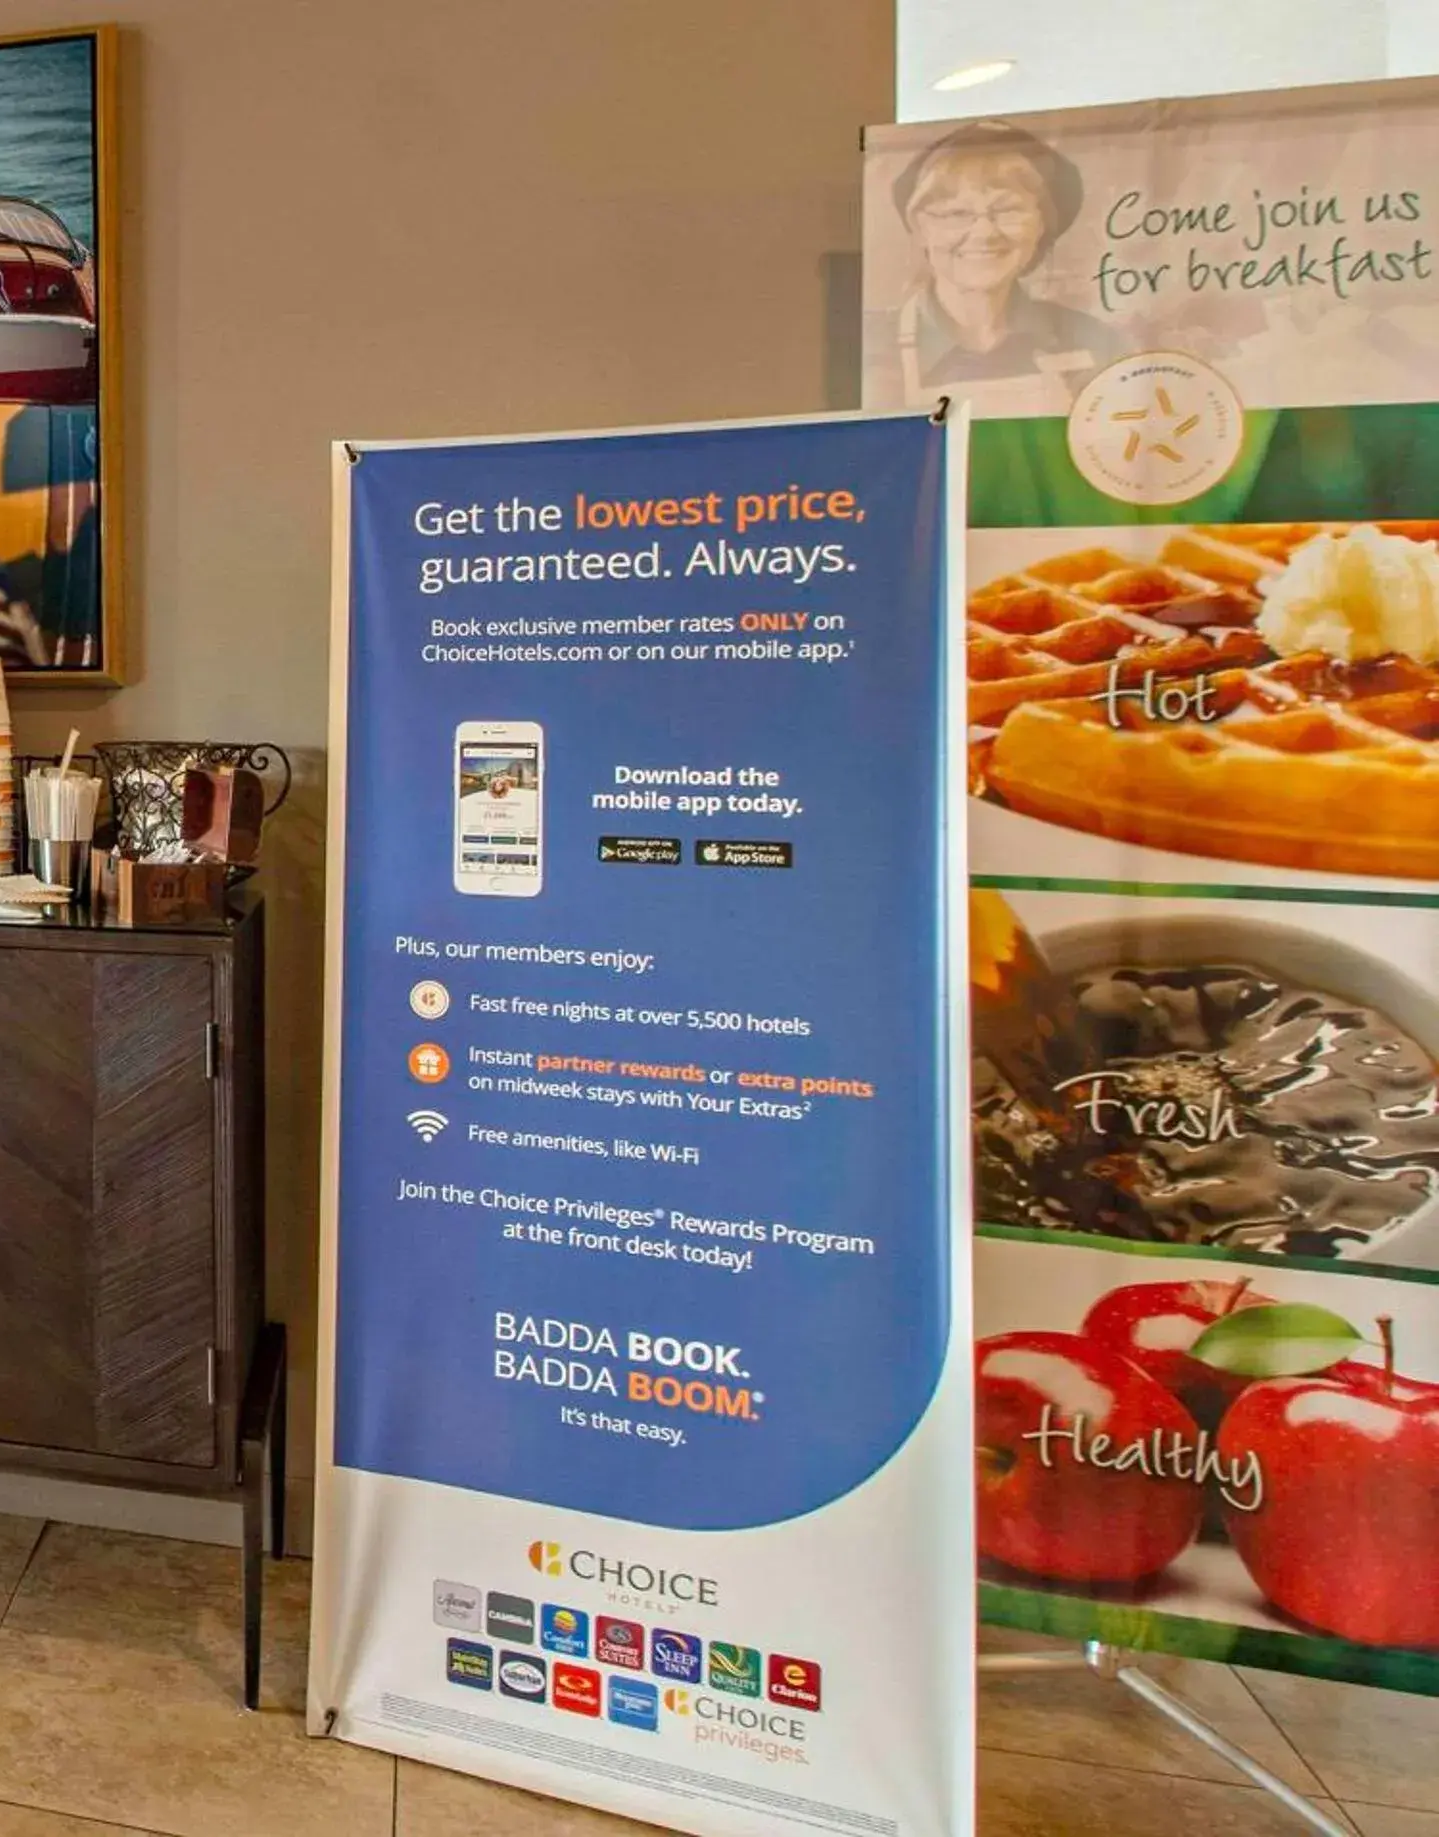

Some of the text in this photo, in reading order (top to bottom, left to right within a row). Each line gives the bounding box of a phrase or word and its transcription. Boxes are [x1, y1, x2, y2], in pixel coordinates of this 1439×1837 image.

[1106, 185, 1421, 250] Come join us
[1092, 238, 1431, 312] for breakfast
[414, 484, 865, 536] Get the lowest price,
[419, 539, 857, 594] guaranteed. Always.
[431, 612, 845, 637] Book exclusive member rates ONLY on
[421, 643, 603, 662] ChoiceHotels.com
[607, 645, 632, 661] or
[636, 645, 665, 661] on
[670, 645, 710, 660] our
[714, 639, 793, 660] mobile
[1089, 662, 1216, 727] Hot
[615, 765, 780, 787] Download the
[592, 790, 803, 818] mobile app today.
[725, 852, 785, 864] App Store
[395, 936, 654, 974] Plus, our members enjoy:
[470, 994, 811, 1036] Fast free nights at over 5,500 hotels
[468, 1075, 494, 1091] on
[497, 1076, 583, 1099] midweek
[586, 1086, 636, 1107] stays
[639, 1089, 683, 1109] with
[687, 1092, 735, 1113] Your
[469, 1046, 874, 1098] Instant partner rewards or extra points
[1053, 1072, 1245, 1142] Fresh
[468, 1124, 699, 1165] Free amenities, like Wi-Fi
[397, 1179, 437, 1201] Join
[440, 1184, 475, 1205] the
[479, 1188, 550, 1214] Choice
[670, 1211, 767, 1241] Rewards
[772, 1223, 875, 1255] Program
[503, 1222, 753, 1274] at the front desk today!
[495, 1312, 750, 1378] BADDA BOOK.
[494, 1349, 618, 1397] BADDA
[590, 1412, 632, 1435] that
[635, 1423, 687, 1448] easy.
[1022, 1404, 1263, 1511] Healthy
[571, 1550, 718, 1606] CHOICE
[771, 1684, 817, 1703] Clarion
[696, 1697, 806, 1740] CHOICE
